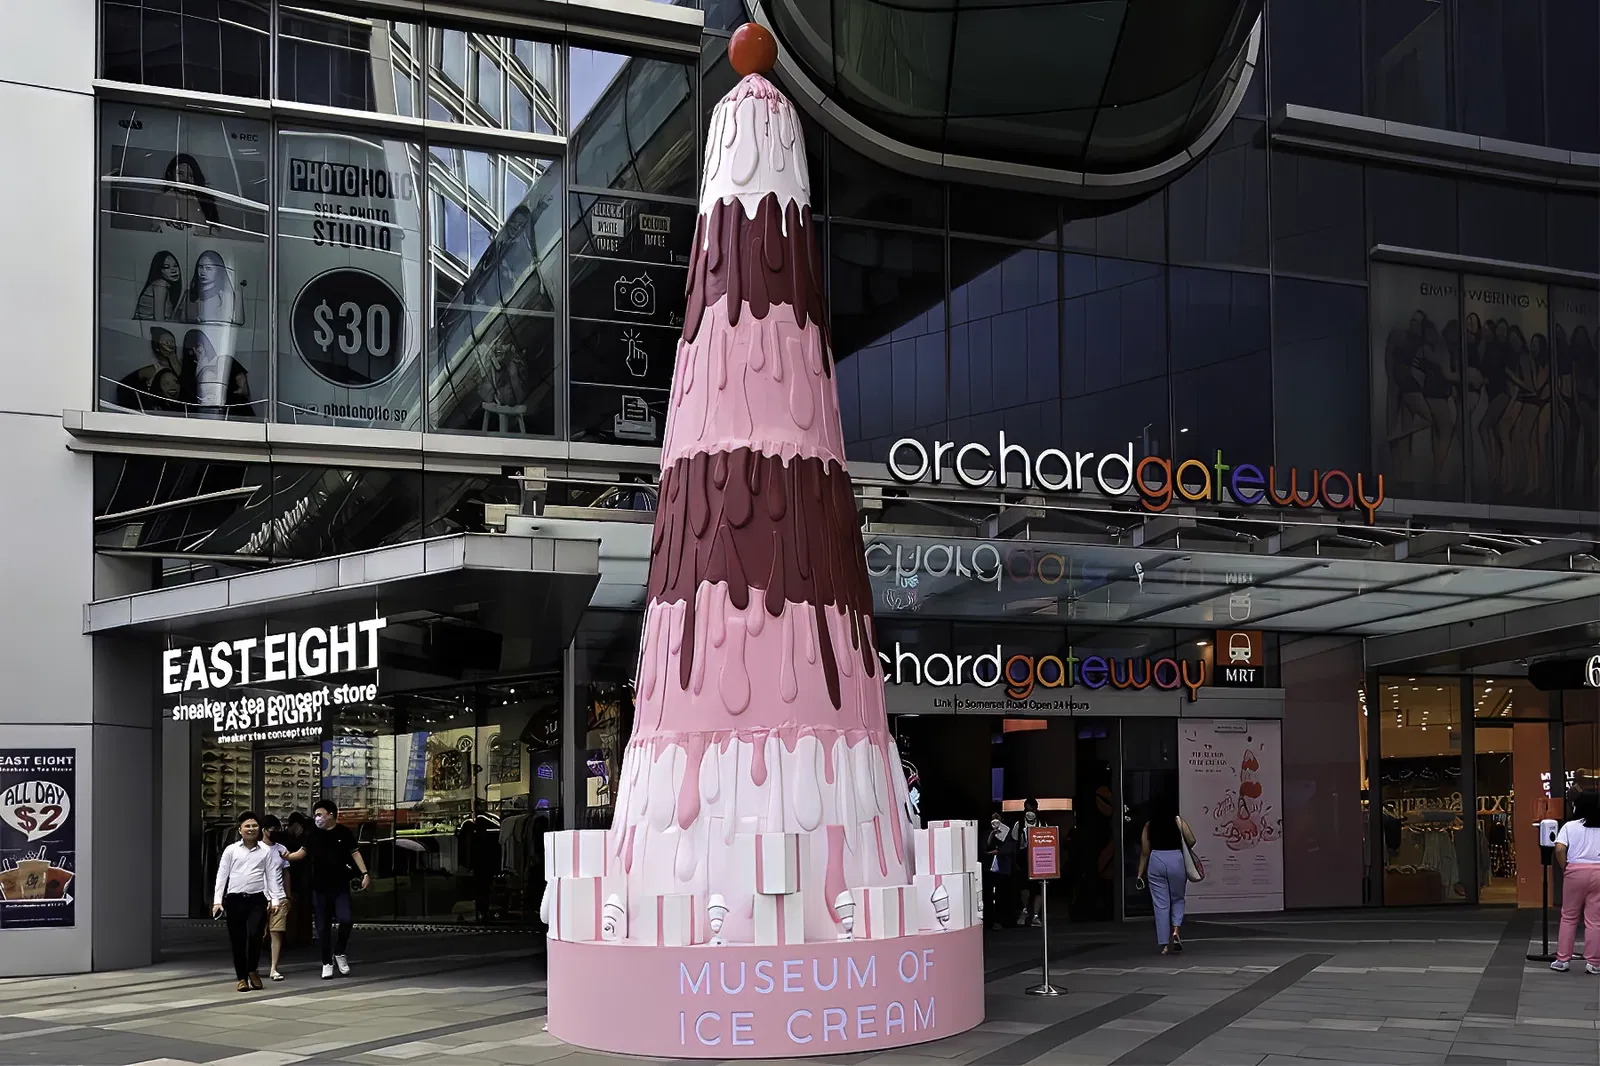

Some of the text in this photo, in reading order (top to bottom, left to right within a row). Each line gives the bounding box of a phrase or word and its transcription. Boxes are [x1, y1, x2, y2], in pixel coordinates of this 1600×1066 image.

[313, 220, 391, 252] STUDIO
[313, 298, 391, 356] $30
[889, 430, 1385, 525] orchardgateway
[162, 617, 387, 695] EAST EIGHT
[1225, 667, 1256, 684] MRT
[172, 697, 227, 721] sneaker
[241, 694, 265, 715] tea
[268, 684, 330, 712] concept
[333, 683, 377, 705] store
[933, 698, 952, 708] Link
[965, 698, 1005, 709] Somerset
[1006, 699, 1027, 710] Road
[1029, 700, 1052, 711] Open
[1053, 700, 1064, 710] 24
[1065, 700, 1090, 710] Hours
[267, 728, 300, 740] concept
[301, 726, 322, 737] store
[34, 756, 74, 766] EIGHT
[5, 781, 65, 806] ALL DAY
[14, 804, 63, 834] $2
[679, 949, 935, 995] MUSEUM OF
[680, 997, 936, 1046] ICE CREAM
